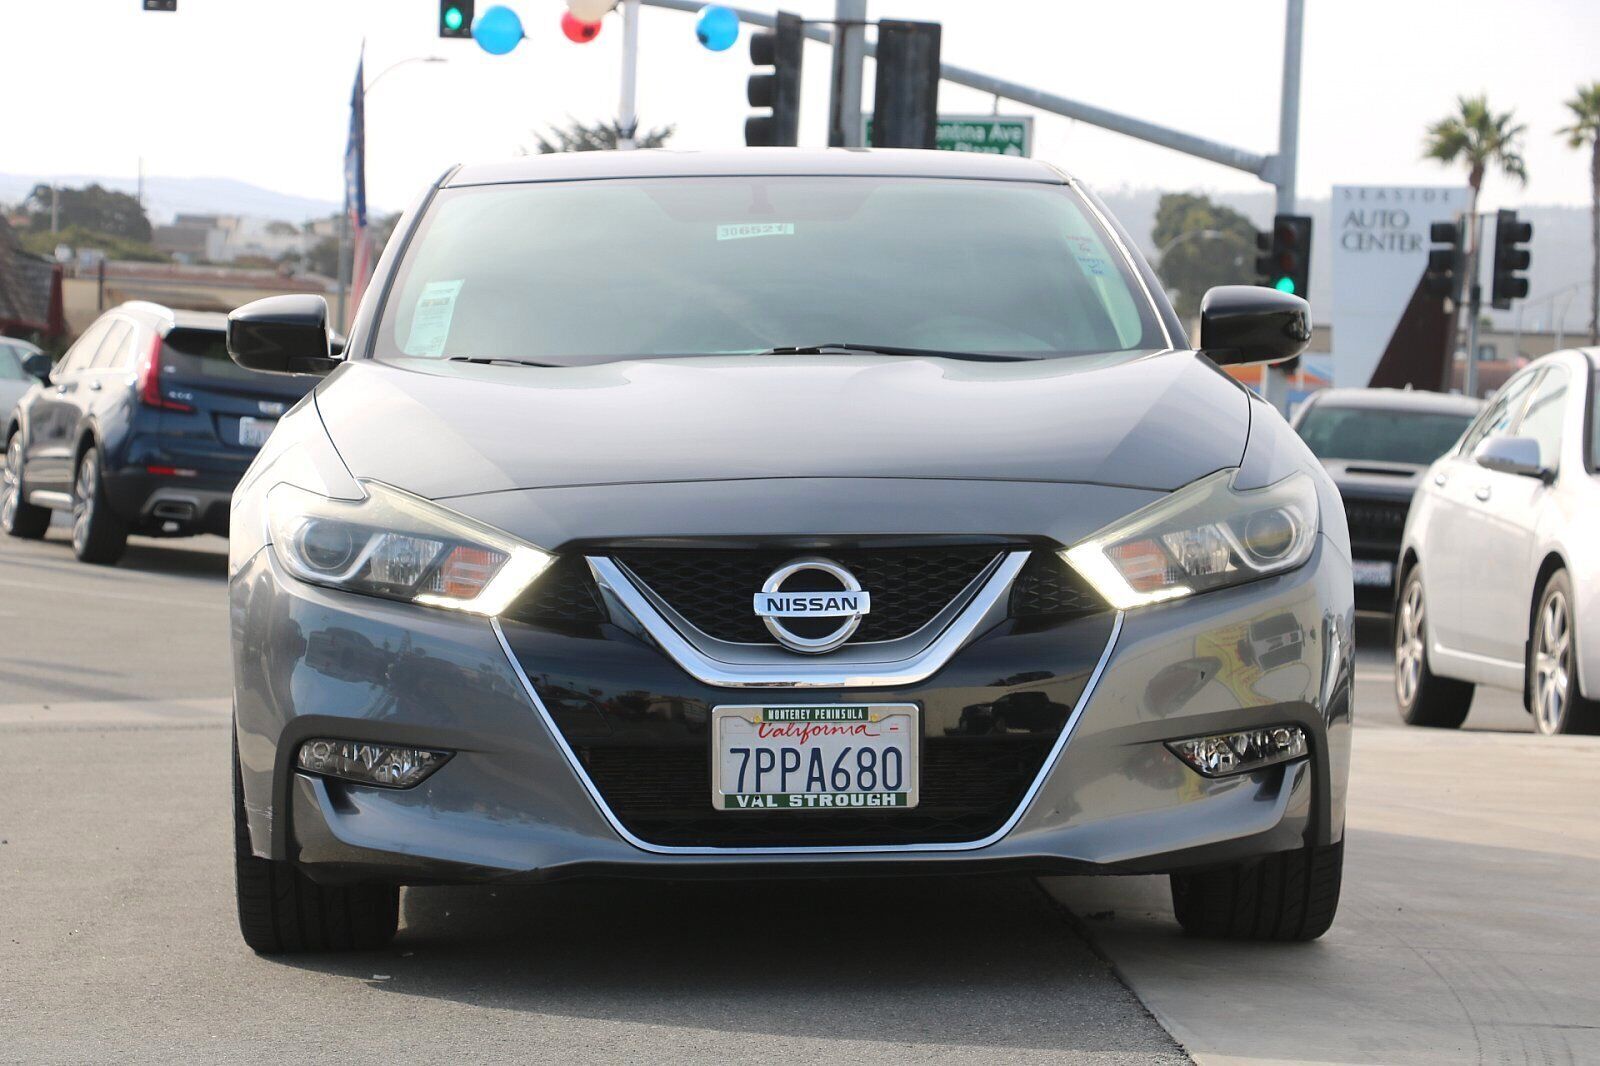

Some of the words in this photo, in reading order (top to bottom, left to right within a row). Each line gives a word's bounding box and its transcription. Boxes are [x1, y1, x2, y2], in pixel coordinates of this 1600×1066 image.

[936, 124, 986, 141] entina
[989, 124, 1022, 142] Ave
[1343, 188, 1450, 201] SEASIDE
[1343, 208, 1411, 229] AUTO
[1341, 230, 1424, 252] CENTER
[766, 597, 858, 612] NISSAN
[768, 709, 811, 720] MONTEREY
[814, 709, 863, 720] PENINSULA
[758, 722, 880, 745] California
[729, 746, 903, 793] 7PPA680
[736, 795, 778, 808] VAL
[788, 794, 896, 808] STROUGH
